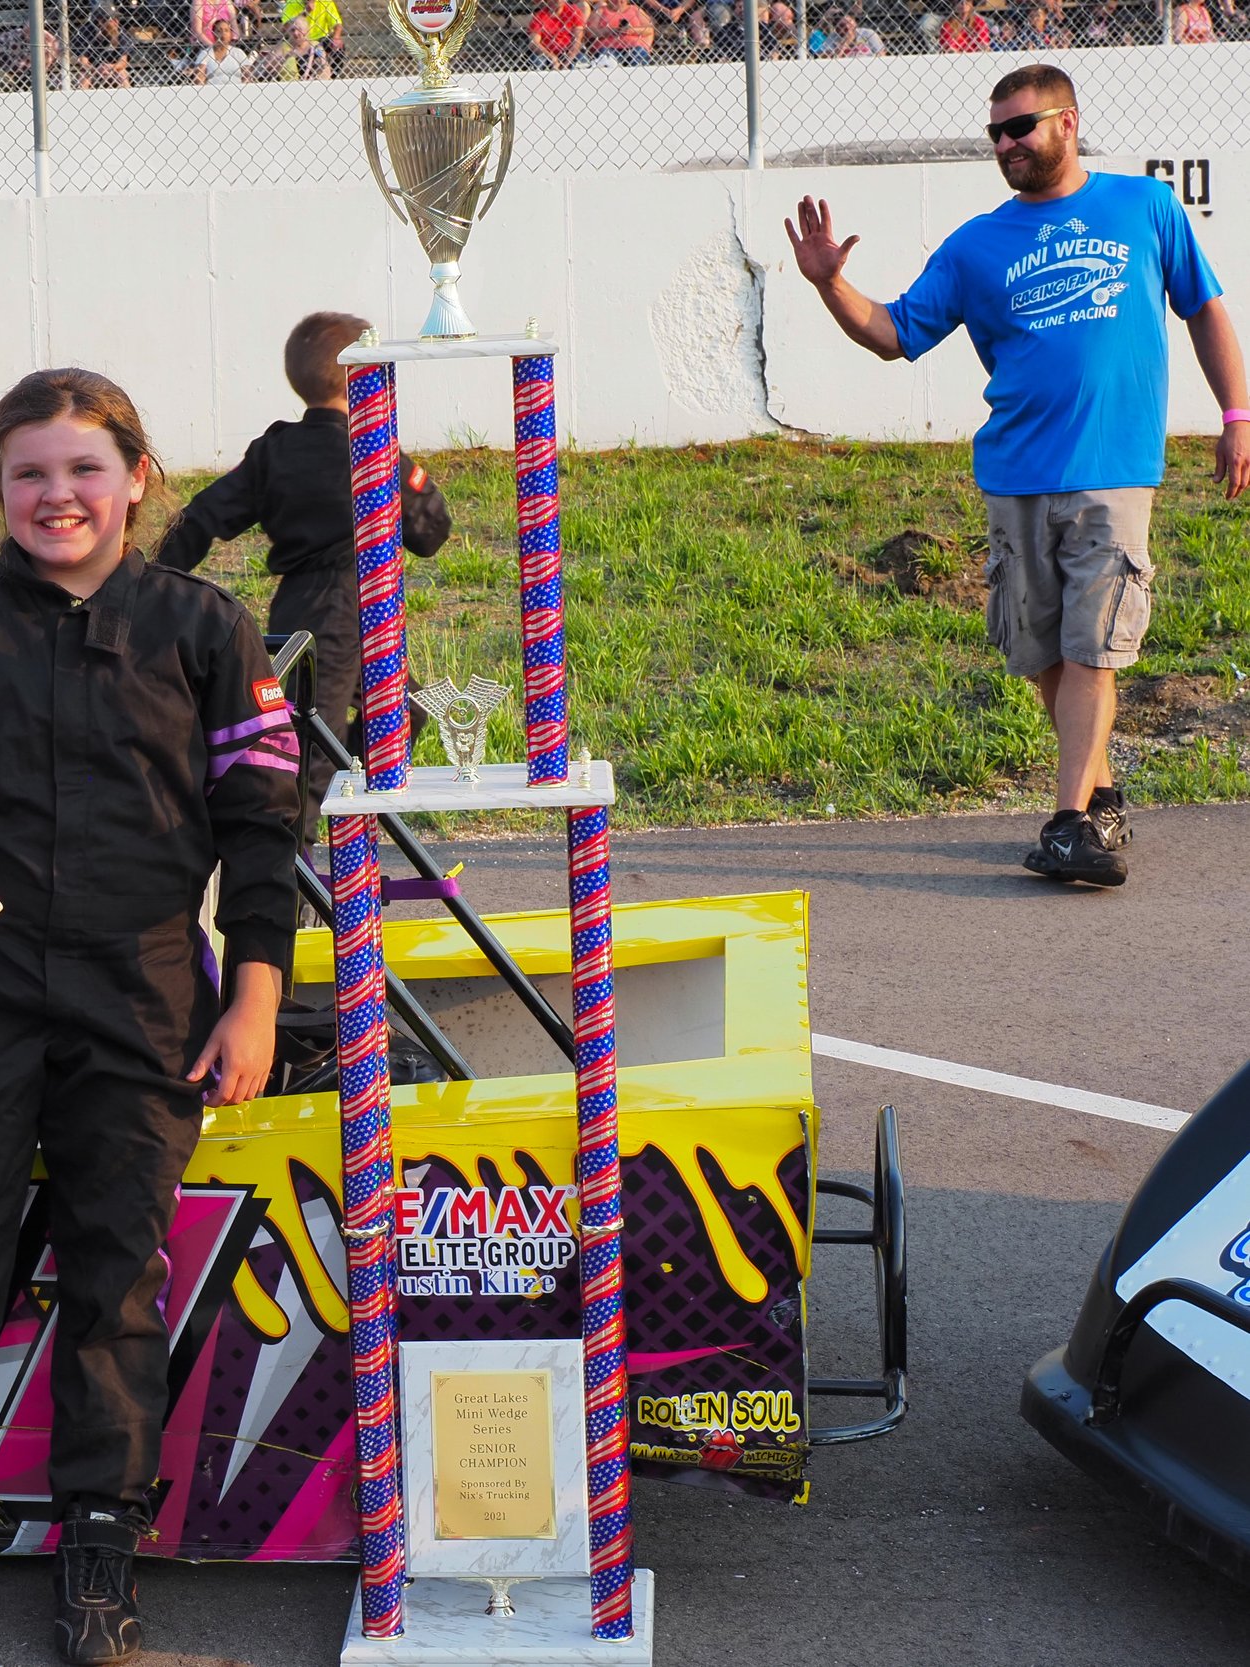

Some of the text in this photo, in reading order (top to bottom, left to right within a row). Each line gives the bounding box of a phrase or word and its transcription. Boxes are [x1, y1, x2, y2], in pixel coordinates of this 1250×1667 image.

[1146, 159, 1210, 205] 60
[1005, 238, 1130, 288] MINI WEDGE
[1011, 263, 1127, 311] RACING FAMILY
[1028, 305, 1118, 331] KLINE RACING
[394, 1189, 569, 1236] E/MAX
[405, 1241, 572, 1267] ELITE GROUP
[400, 1271, 471, 1294] ustin
[454, 1392, 529, 1404] Great Lakes
[456, 1408, 529, 1420] Mini Wedge
[640, 1394, 798, 1428] ROLLIN SOUL
[473, 1423, 512, 1434] Series
[469, 1443, 516, 1454] SENIOR
[459, 1457, 528, 1468] CHAMPION
[461, 1479, 527, 1490] Sponsored By
[459, 1490, 530, 1501] Nix's Trucking
[484, 1511, 507, 1521] 2021
